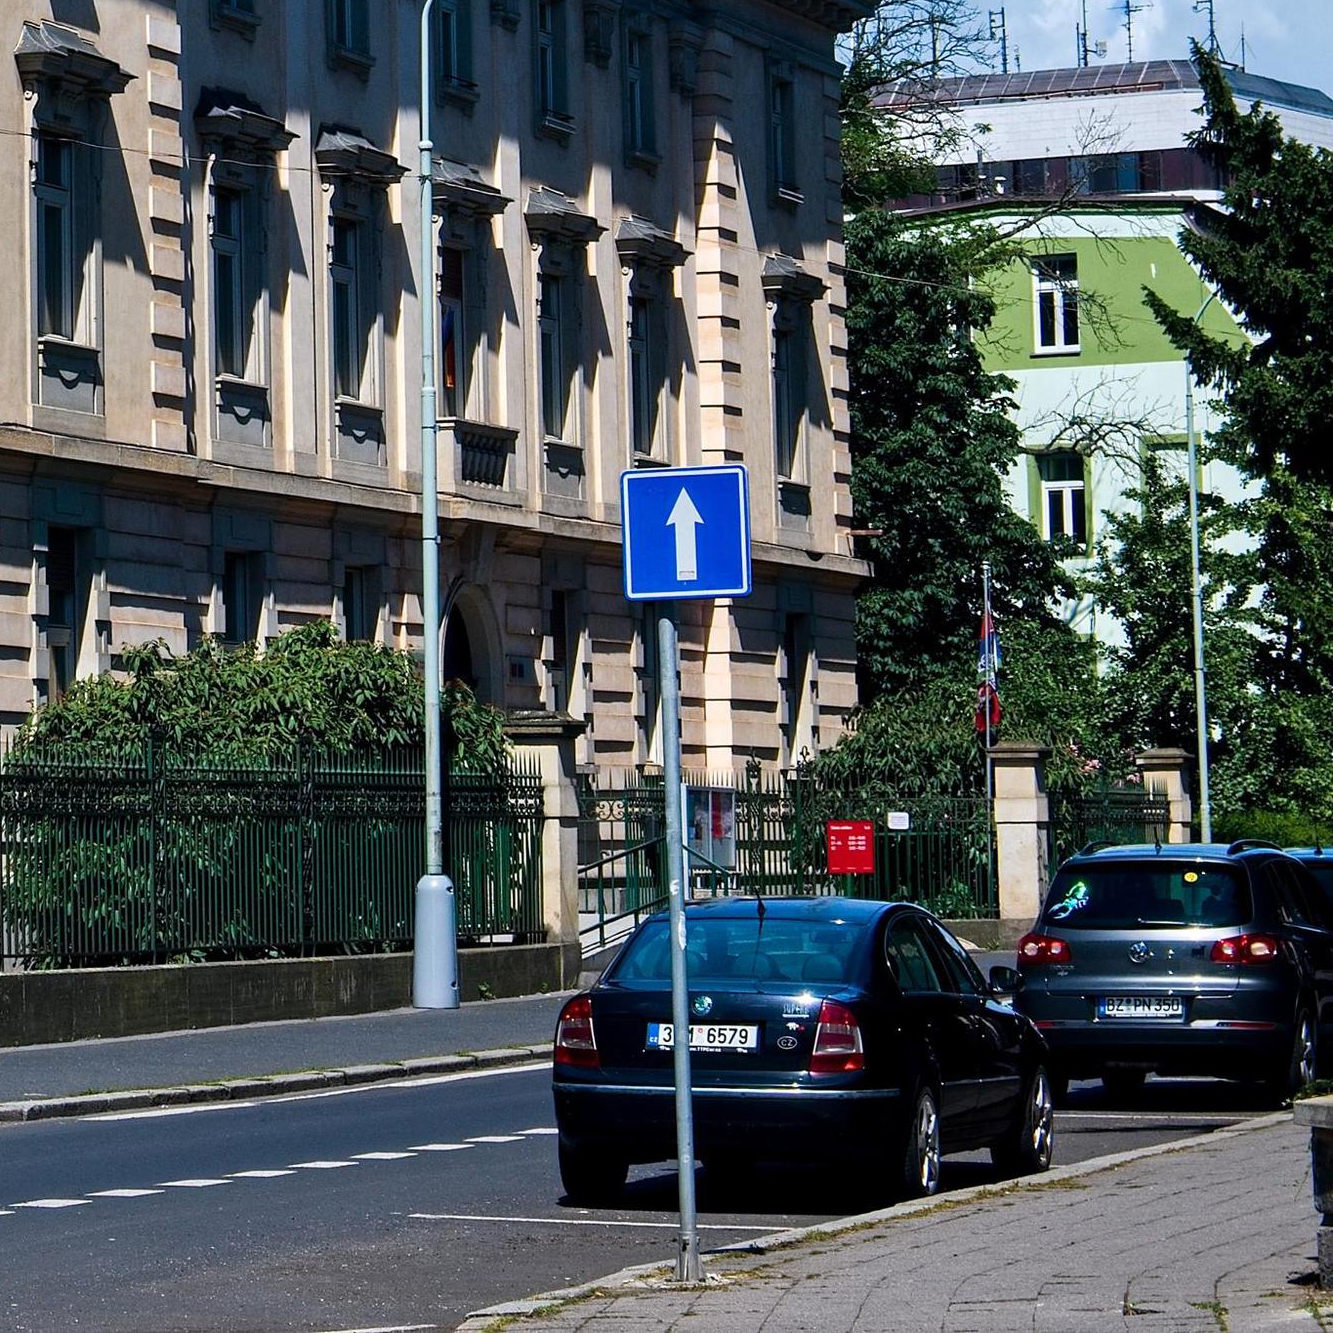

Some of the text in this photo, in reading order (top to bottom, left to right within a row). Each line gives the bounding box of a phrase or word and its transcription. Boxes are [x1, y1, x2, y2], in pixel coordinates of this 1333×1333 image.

[1106, 998, 1124, 1012] BZ
[1134, 998, 1151, 1012] PN
[707, 1028, 749, 1045] 6579
[781, 1039, 793, 1047] CZ
